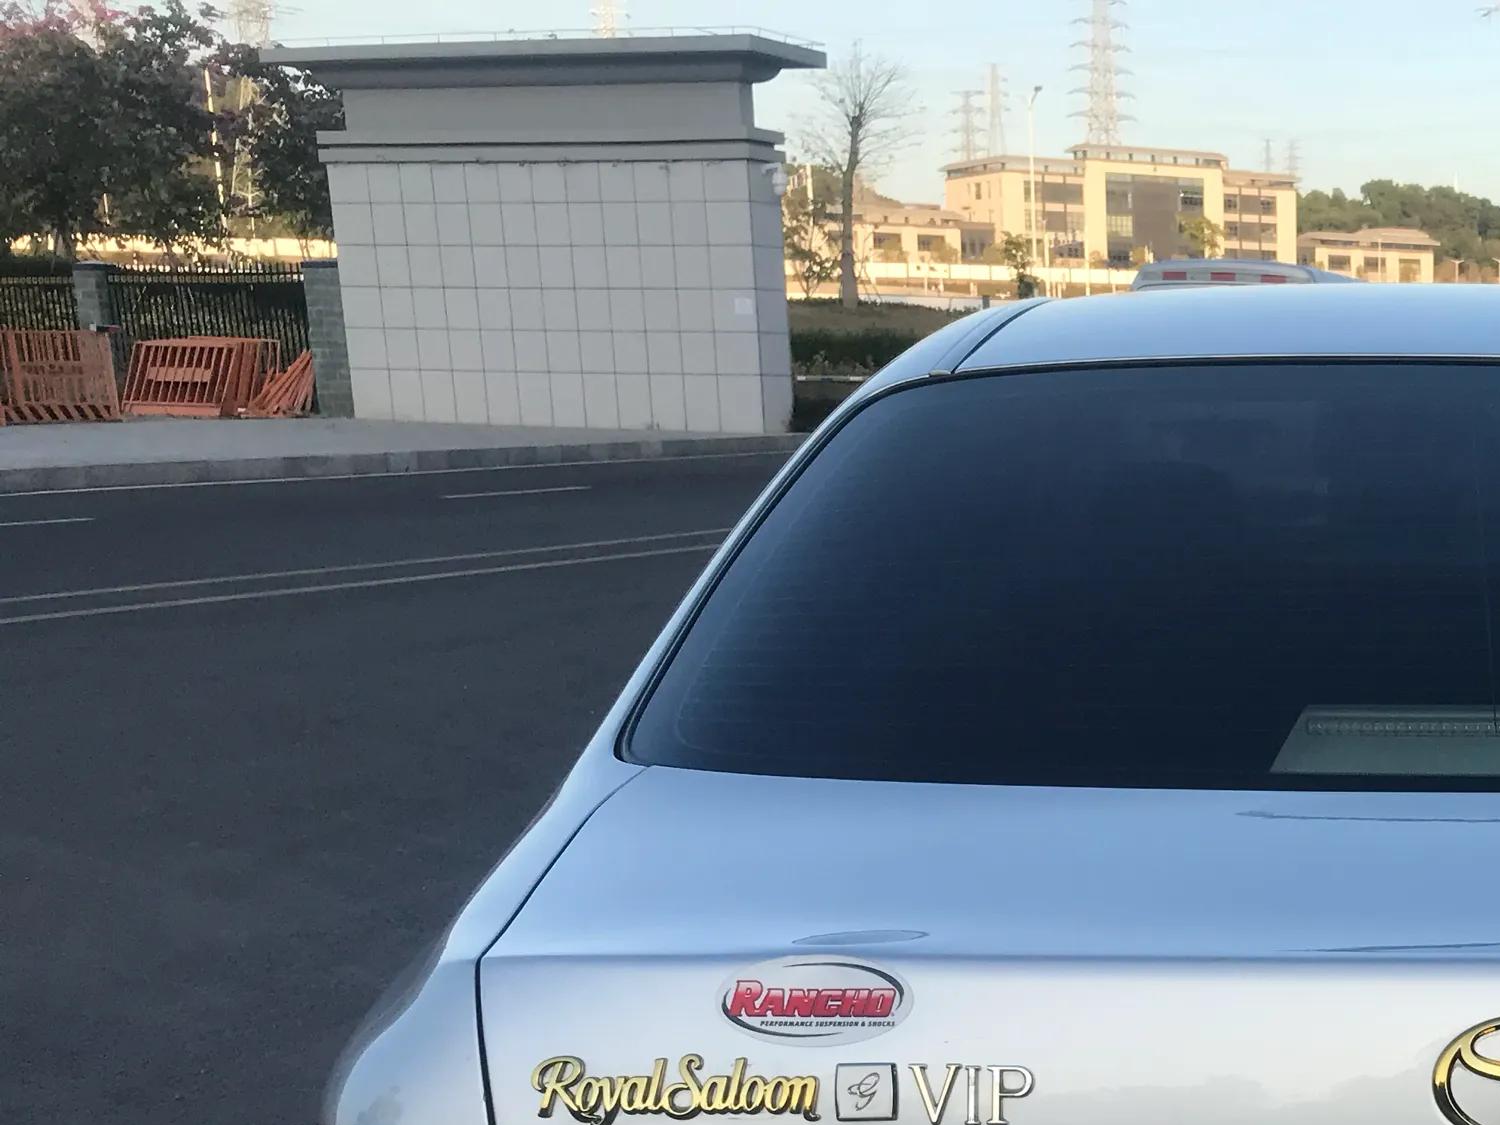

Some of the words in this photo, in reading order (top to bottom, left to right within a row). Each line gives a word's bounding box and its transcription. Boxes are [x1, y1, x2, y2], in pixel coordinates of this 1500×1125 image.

[729, 980, 897, 1017] RANCHO
[760, 1020, 814, 1028] PERFORMANCE
[815, 1020, 860, 1028] SUSPENSION
[867, 1020, 896, 1028] SHOCKS
